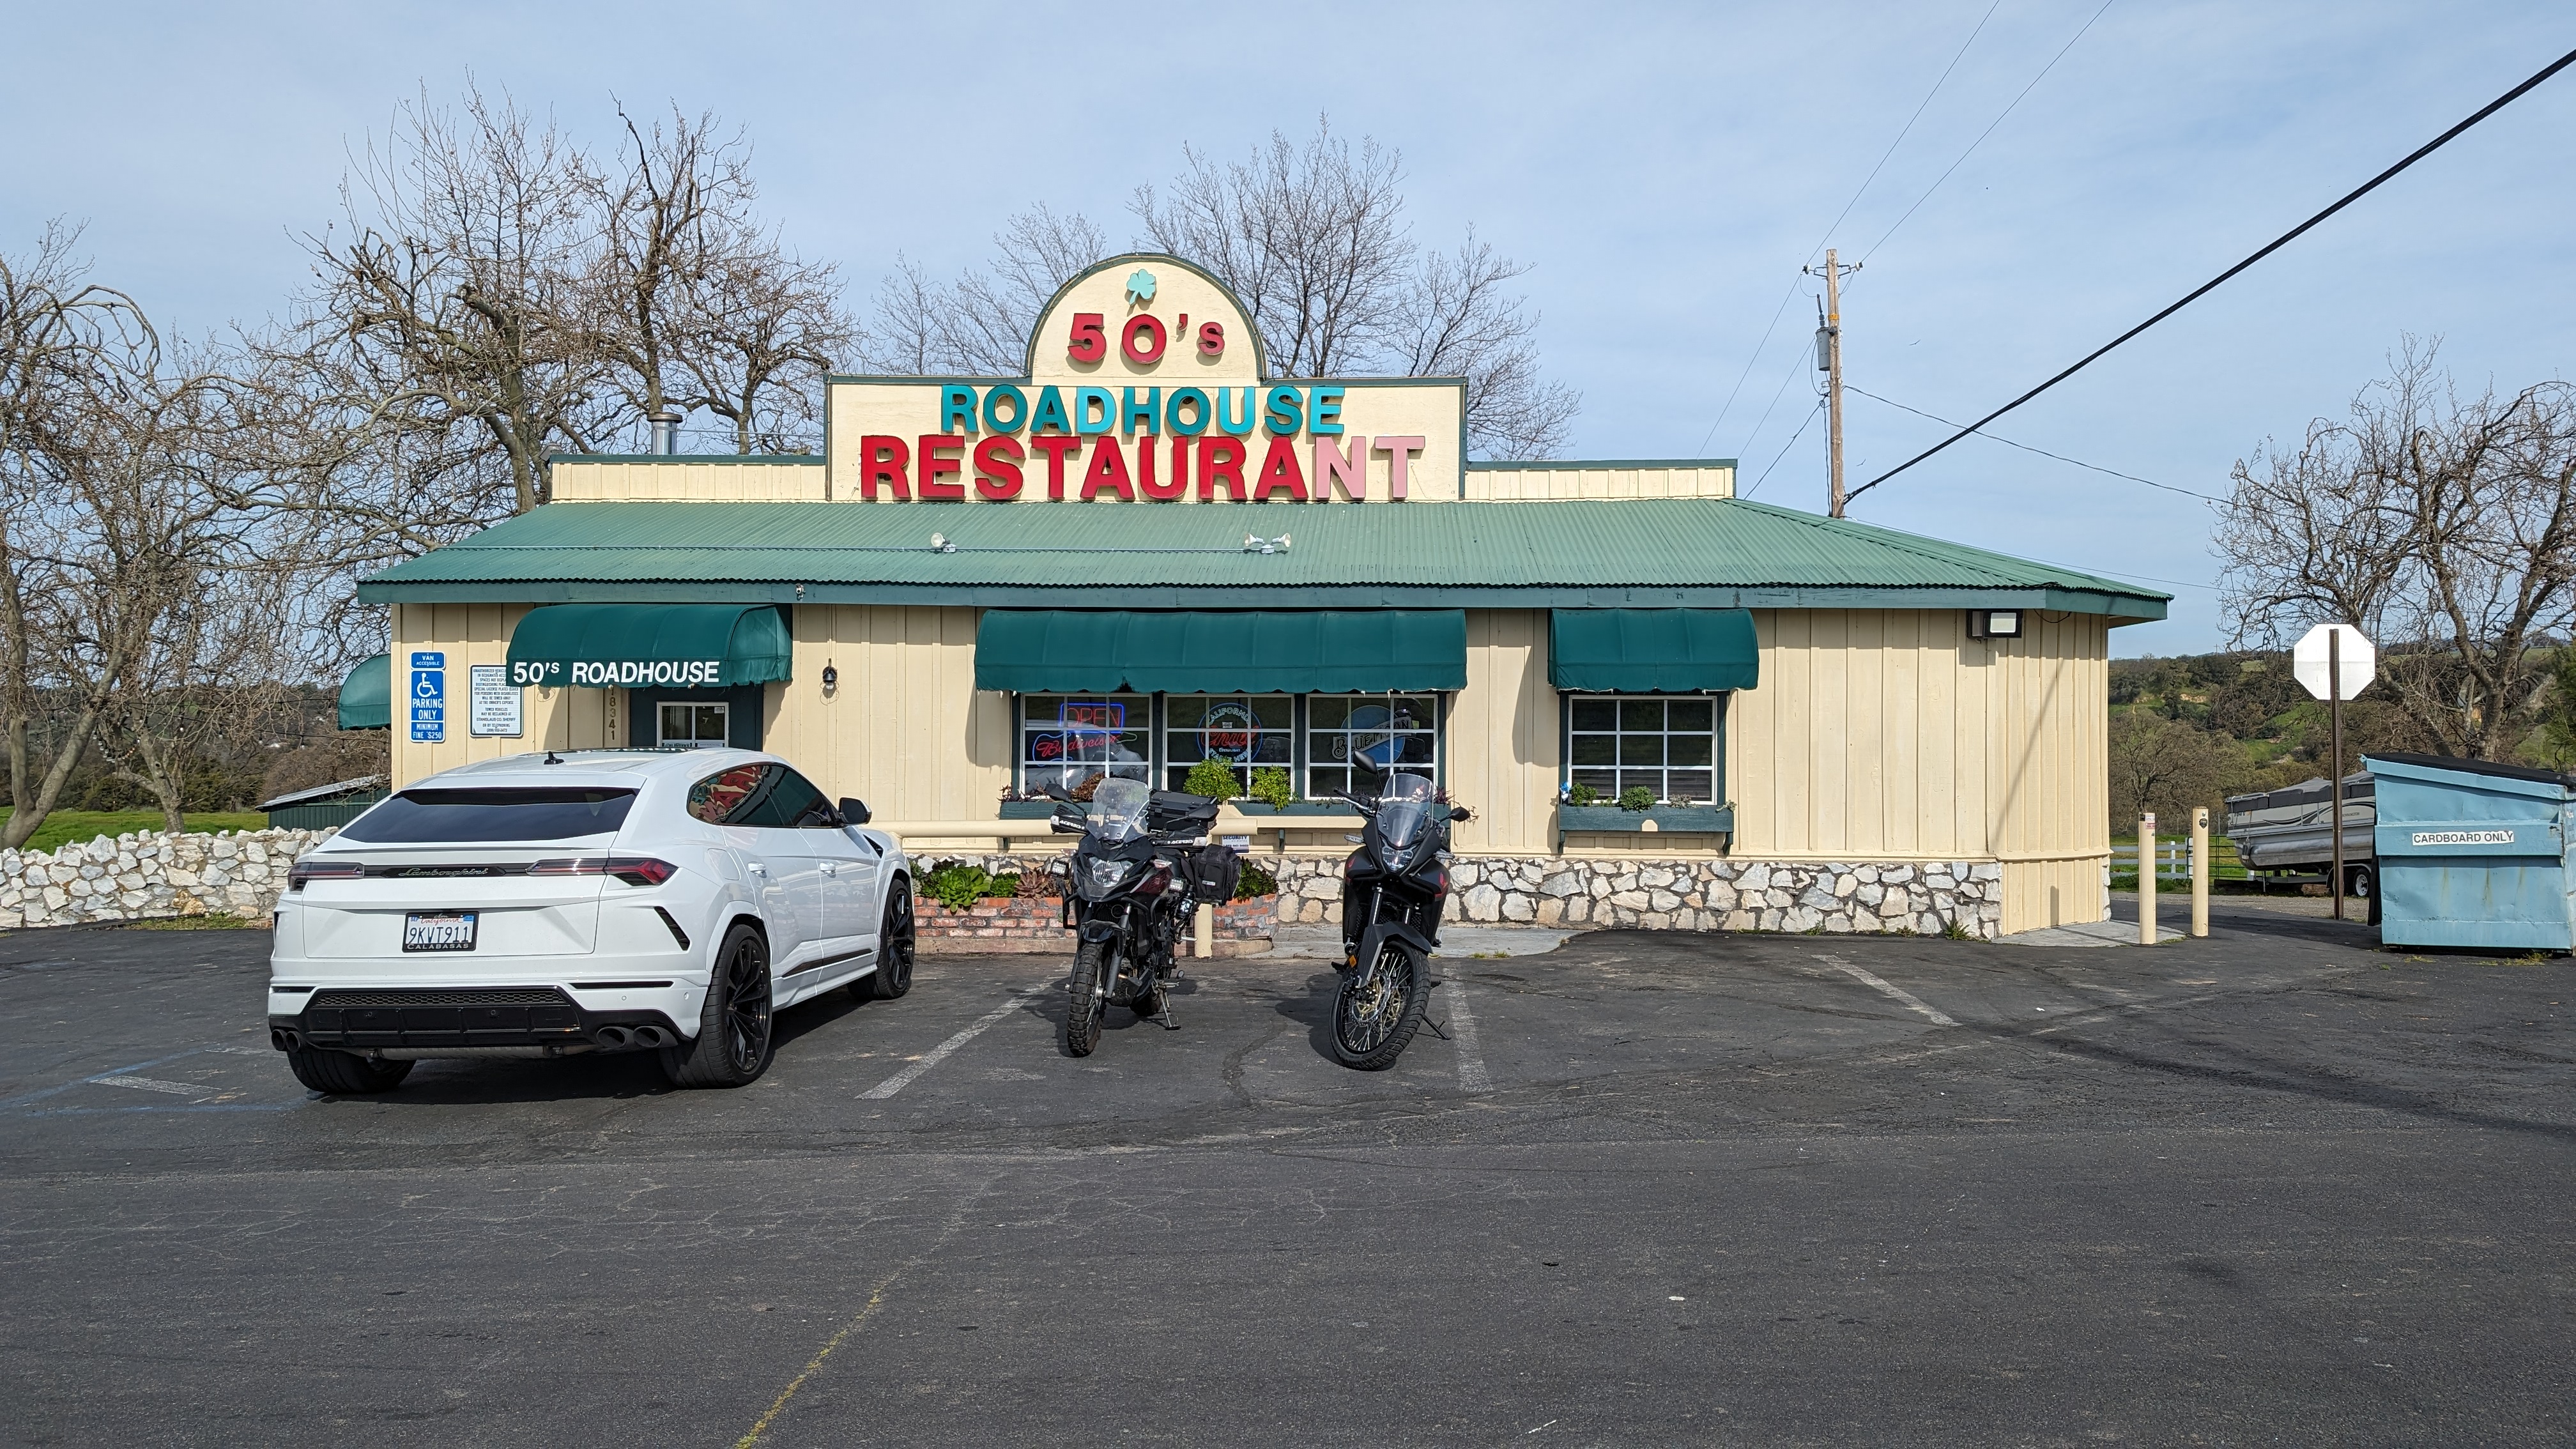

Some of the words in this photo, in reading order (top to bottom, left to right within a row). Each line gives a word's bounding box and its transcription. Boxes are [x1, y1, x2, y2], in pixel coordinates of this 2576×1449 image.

[1068, 312, 1225, 364] 50's
[941, 384, 1346, 436] ROADHOUSE
[860, 435, 1426, 500] RESTAURANT
[572, 661, 719, 684] ROADHOUSE
[412, 698, 443, 709] PARKING
[418, 709, 437, 720] ONLY
[1064, 707, 1121, 728] OPEN
[2414, 834, 2481, 843] CARDBOARD
[2484, 832, 2513, 842] ONLY
[398, 868, 489, 877] Lamborghini
[420, 918, 464, 926] California
[408, 926, 470, 944] 9KVT911
